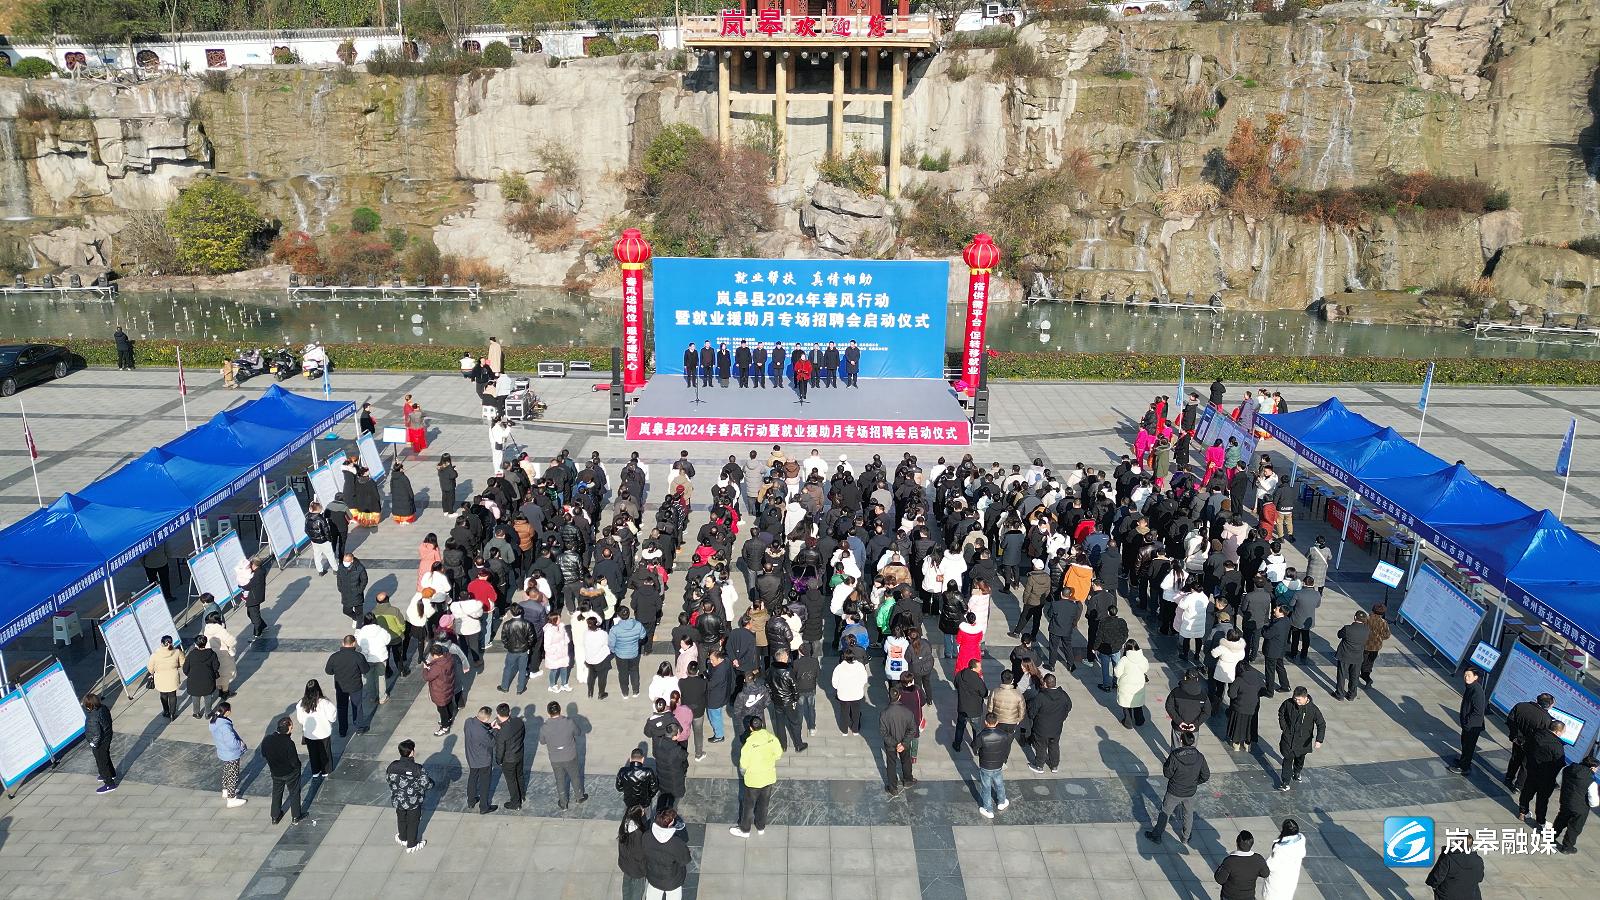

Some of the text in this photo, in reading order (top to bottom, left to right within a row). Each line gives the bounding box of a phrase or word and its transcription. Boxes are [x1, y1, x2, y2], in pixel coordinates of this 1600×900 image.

[720, 8, 887, 38] 岚皋欢迎您
[734, 271, 873, 287] 就业帮扶 真情相助
[625, 277, 637, 322] 春风送岗位
[715, 291, 890, 309] 岚皋县2024年春风行动
[675, 310, 930, 329] 暨就业援助月专场招聘会启动仪式
[967, 282, 985, 375] 搭供需平台 促转移就业
[638, 422, 958, 440] 岚皋县2024年春风行动暨就业援助月专场招聘会启动仪式
[1433, 534, 1490, 577] 昆山市招聘专区
[1522, 595, 1595, 654] 常州新北区招聘专区
